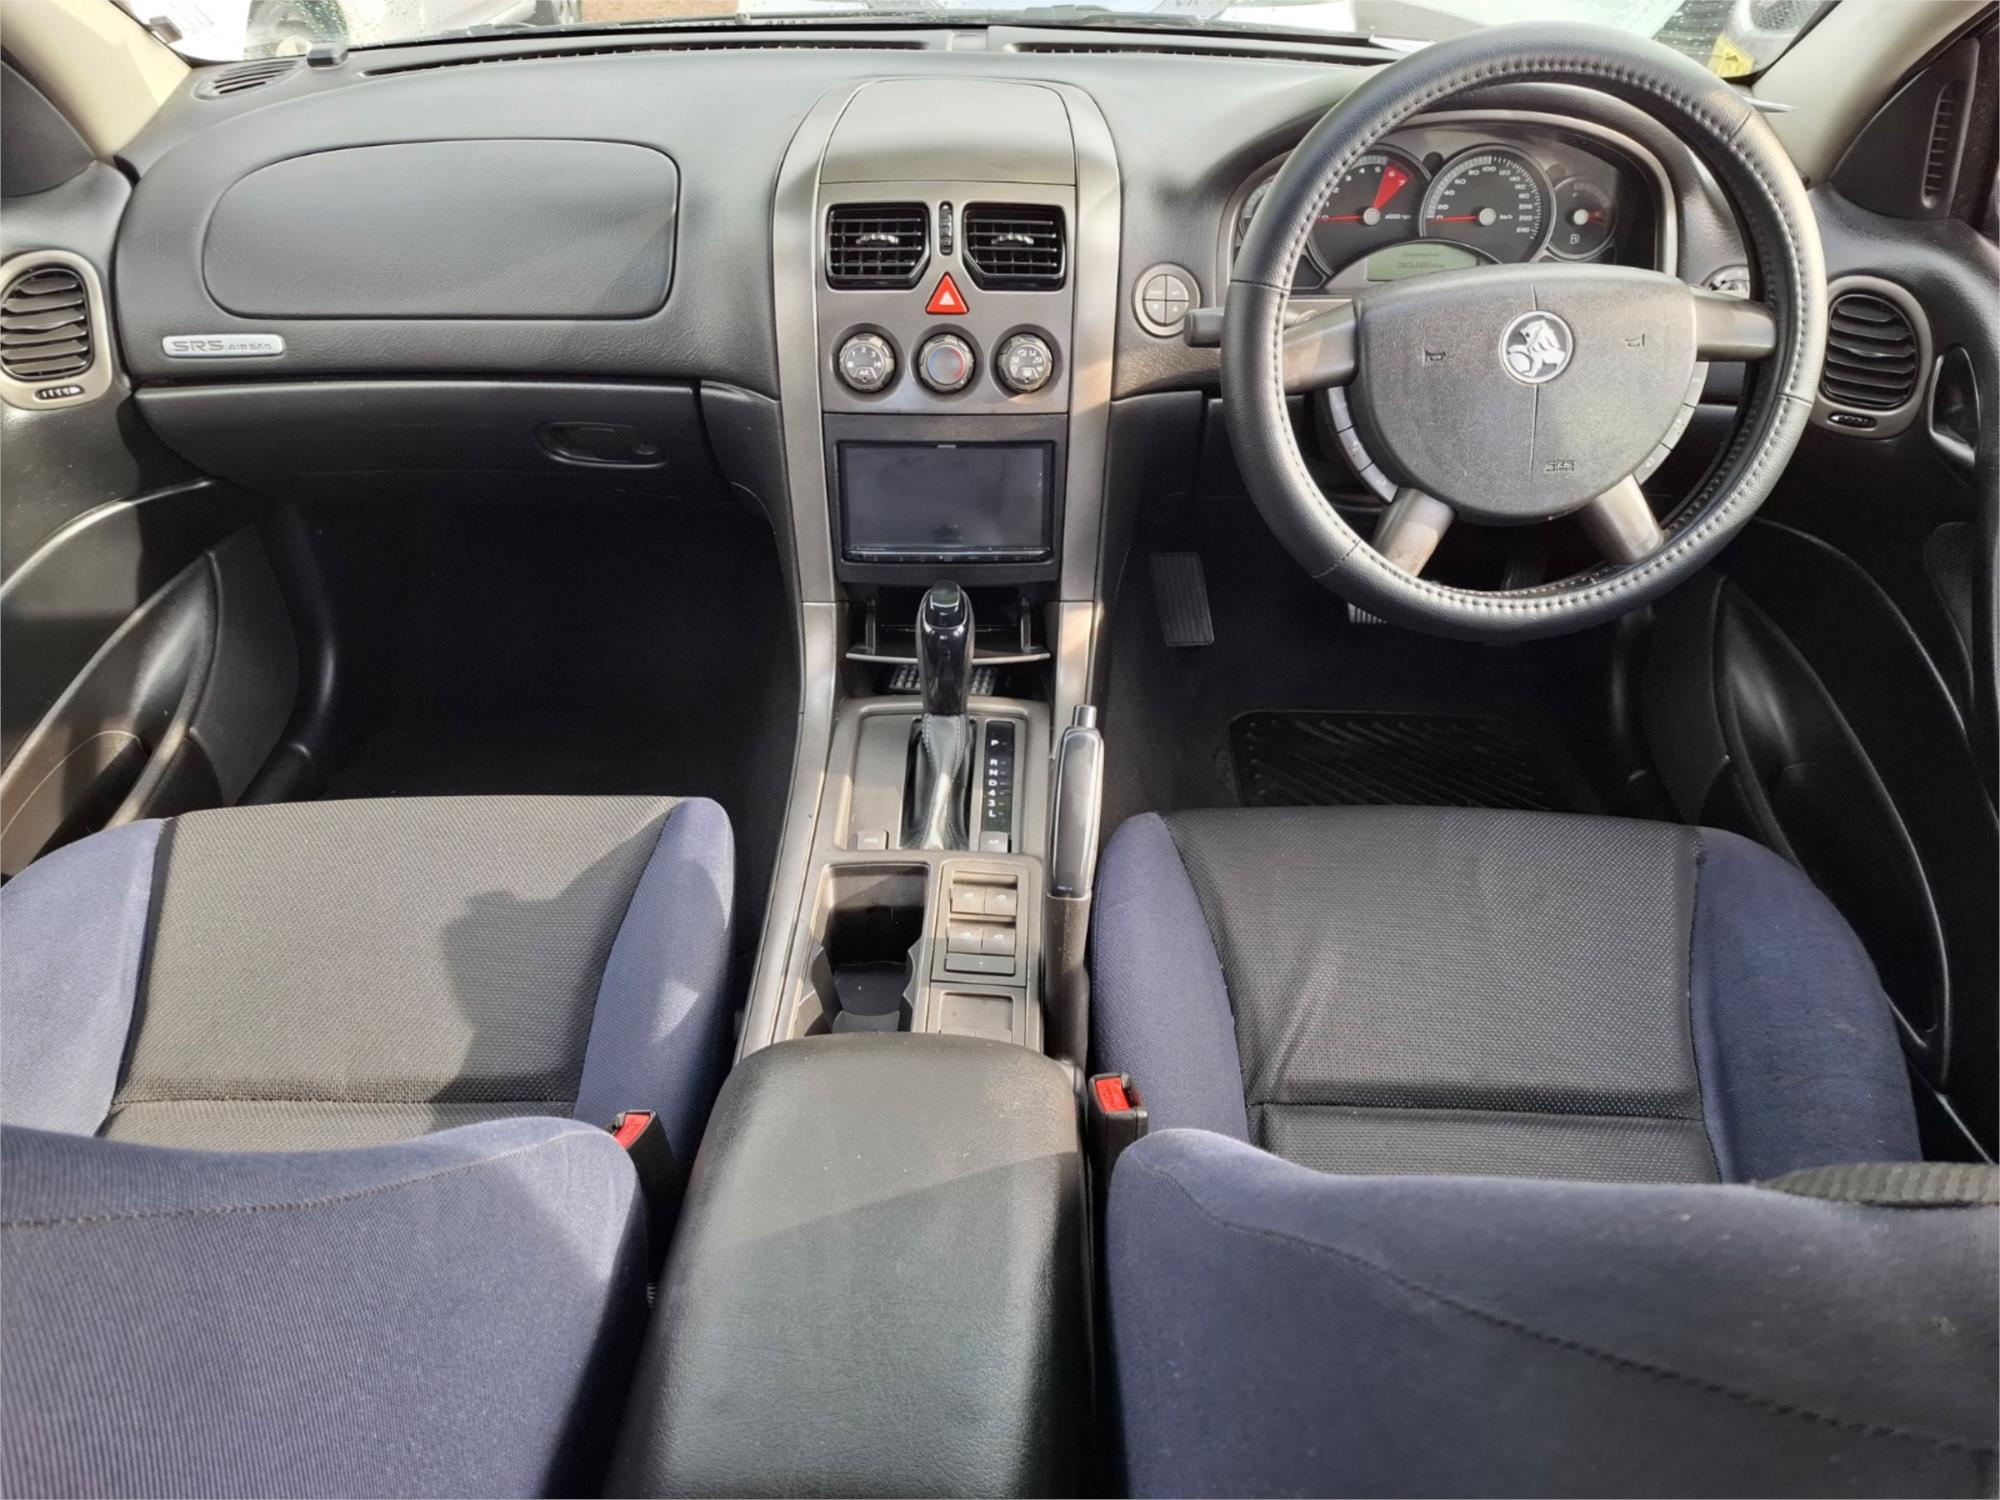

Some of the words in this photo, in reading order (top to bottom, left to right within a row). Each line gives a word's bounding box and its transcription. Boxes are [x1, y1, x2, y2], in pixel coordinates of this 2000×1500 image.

[172, 340, 224, 352] SRS
[988, 779, 997, 787] D
[988, 799, 996, 807] 3
